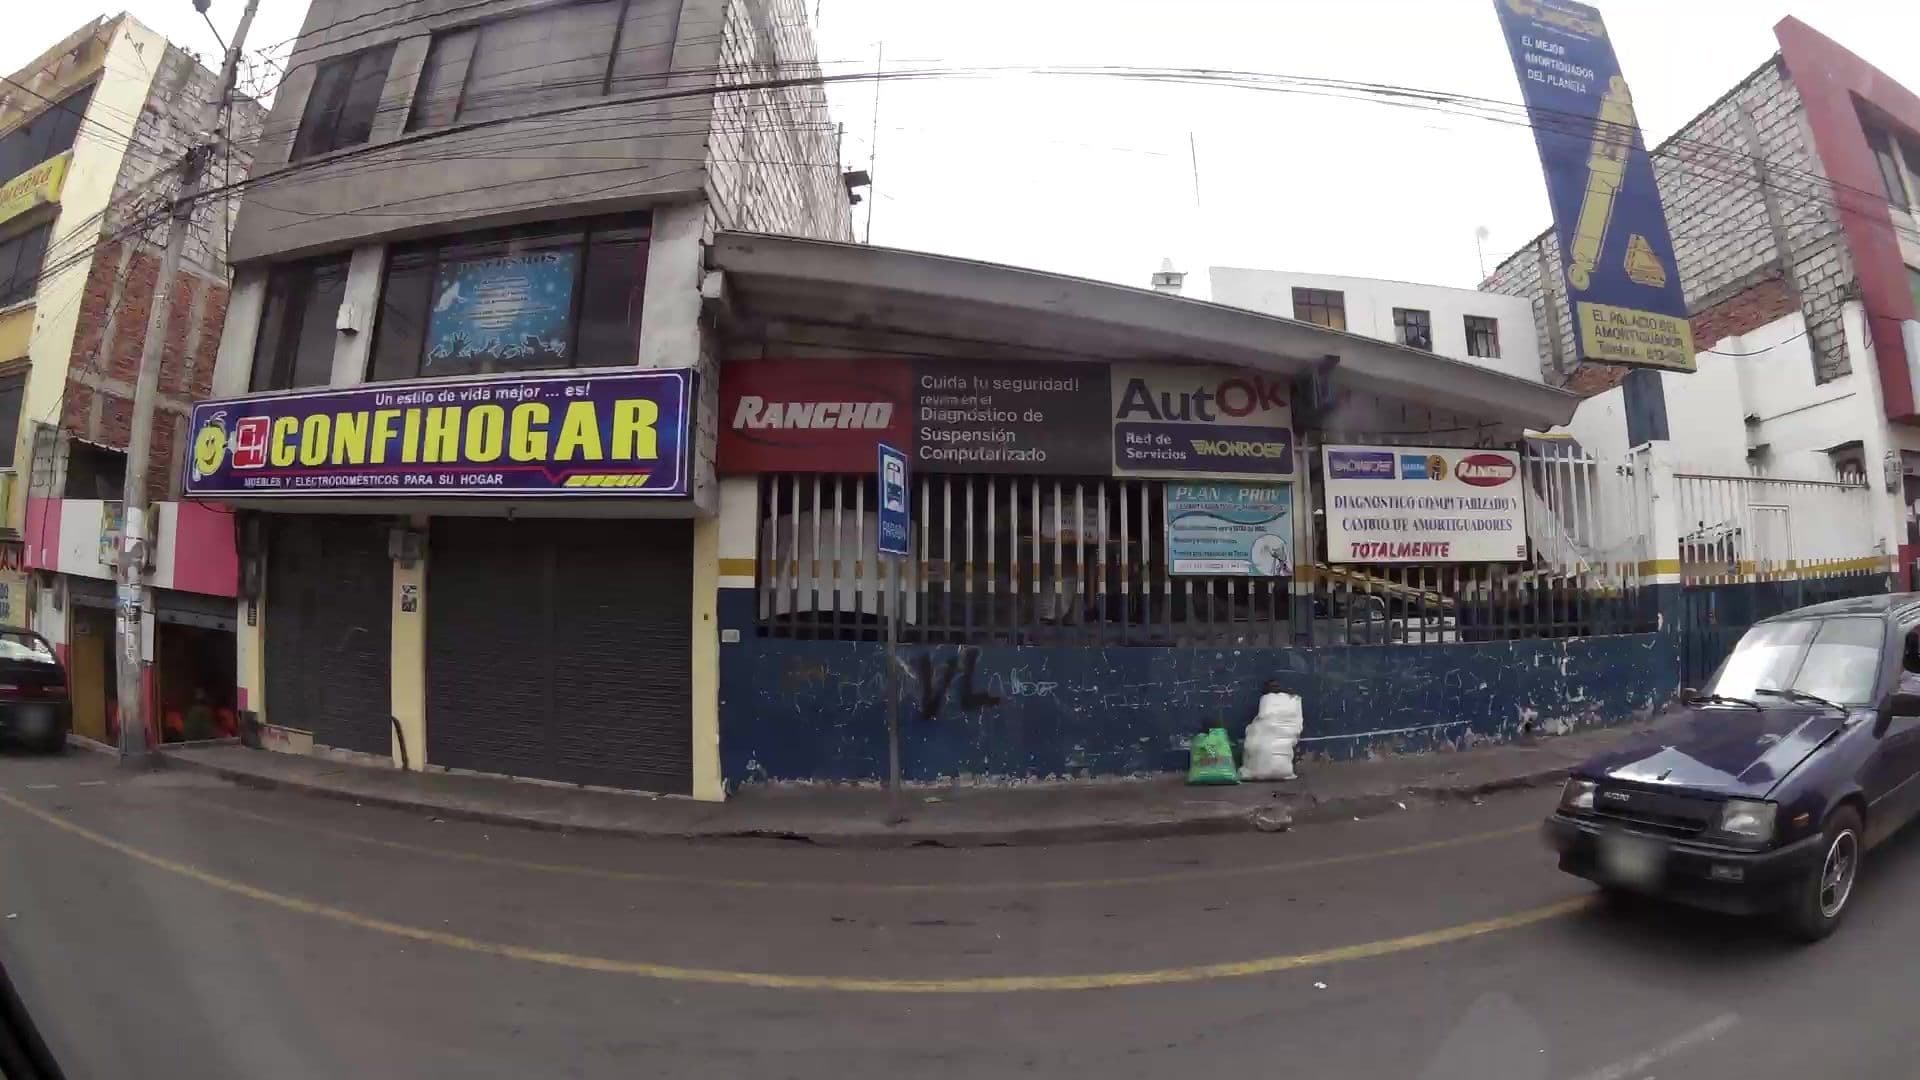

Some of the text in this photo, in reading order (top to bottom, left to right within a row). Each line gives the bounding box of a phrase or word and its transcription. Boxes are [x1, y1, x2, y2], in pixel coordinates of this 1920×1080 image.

[1527, 69, 1546, 82] DEL
[1592, 309, 1607, 322] EL
[920, 375, 967, 390] Cuida
[993, 376, 1079, 393] seguridad!
[375, 392, 393, 405] Un
[397, 391, 433, 404] estilo
[438, 390, 455, 402] de
[460, 388, 491, 401] vida
[496, 386, 541, 402] mejor
[732, 396, 893, 429] RANCHO
[1023, 409, 1044, 422] de
[271, 399, 659, 467] CONFIHOGAR
[920, 427, 1016, 443] Suspensión
[1126, 432, 1172, 444] Red de
[919, 446, 1047, 464] Computarizado
[1127, 448, 1187, 460] Servicios
[1190, 440, 1286, 458] MONROE
[244, 475, 281, 487] MUEBLES
[285, 477, 291, 486] Y
[404, 474, 433, 485] PARA
[438, 475, 454, 485] SU
[461, 474, 503, 485] HOGAR
[1175, 487, 1221, 500] PLAN
[1351, 542, 1450, 558] TOTALMENTE
